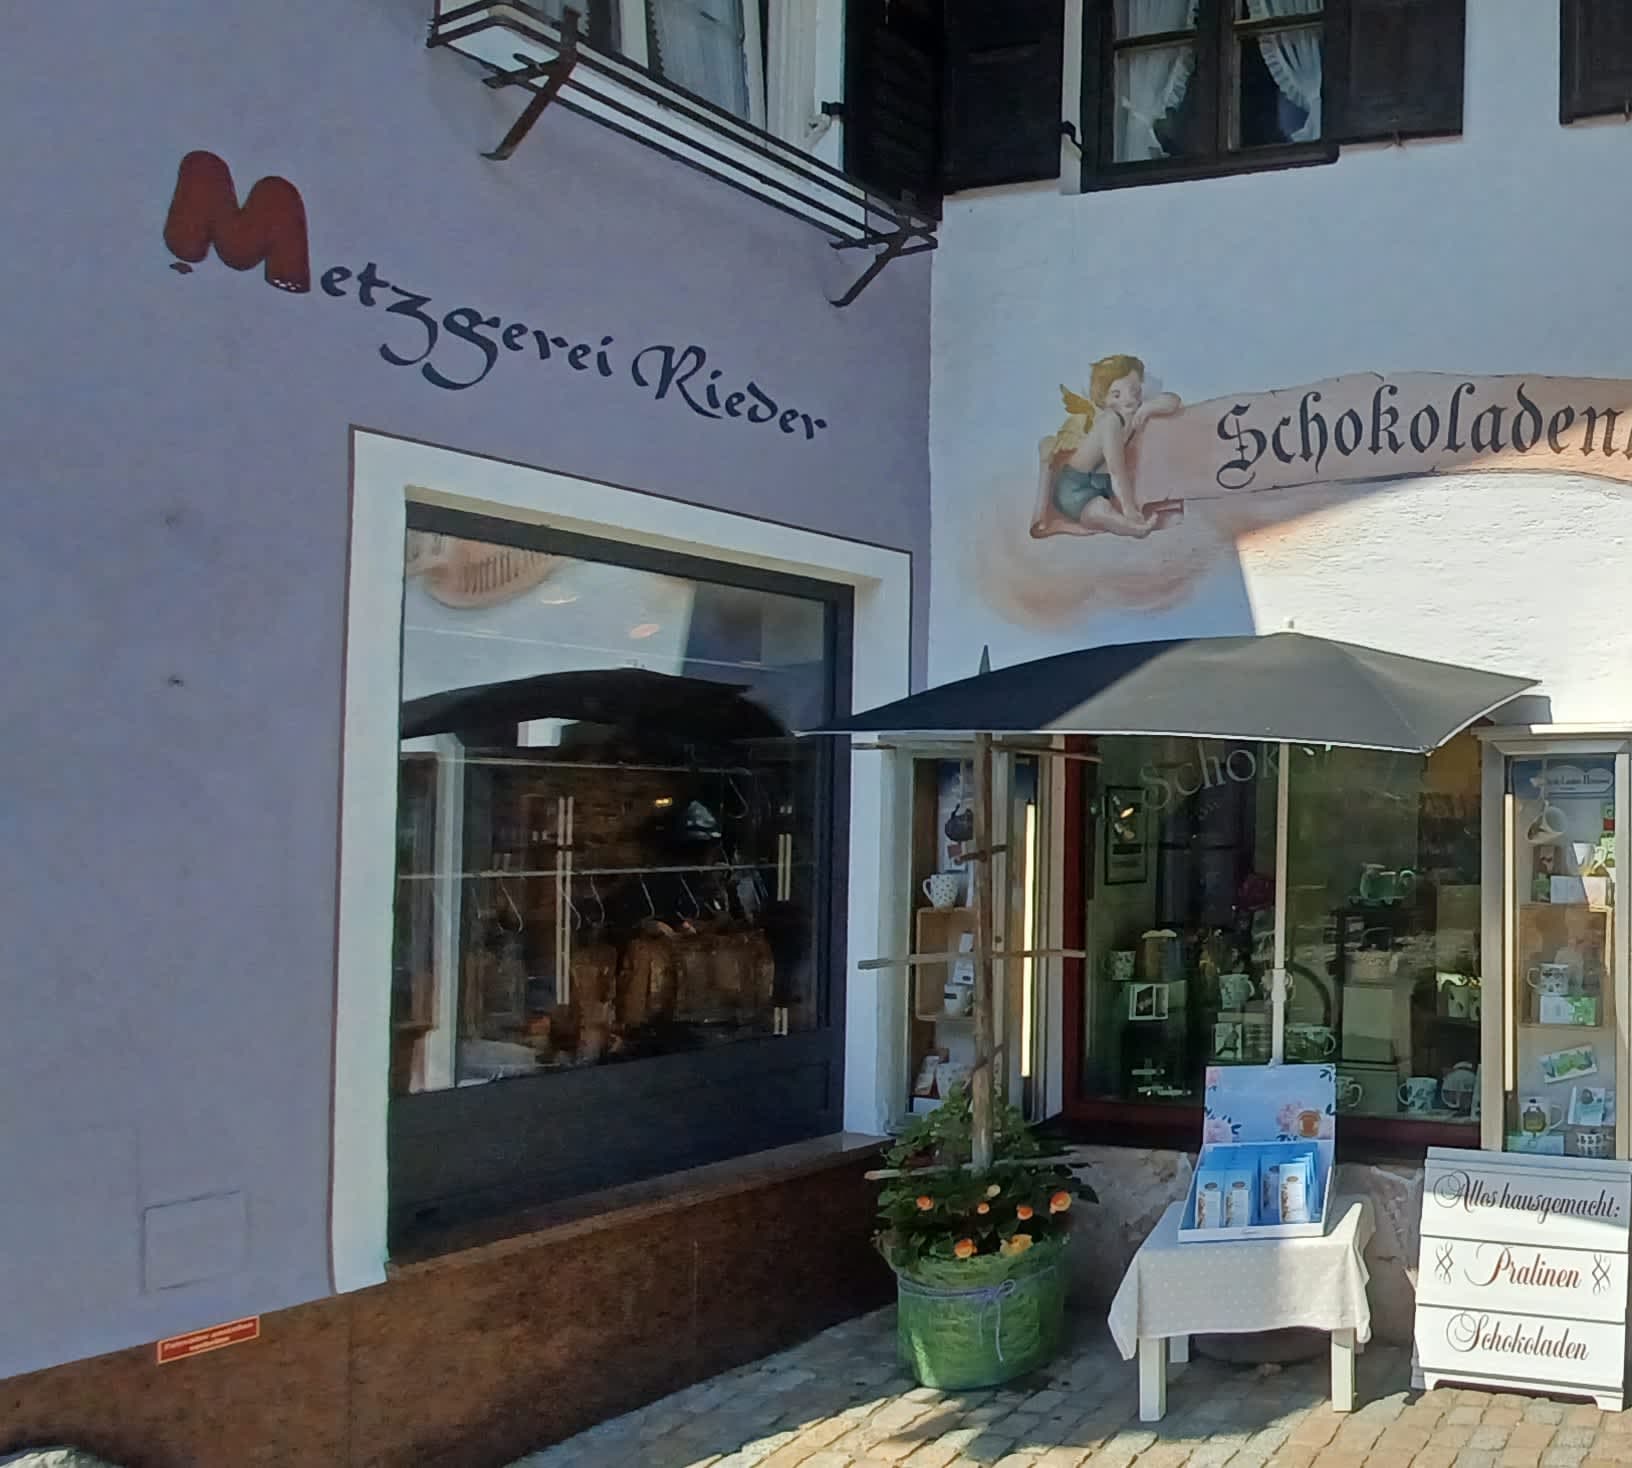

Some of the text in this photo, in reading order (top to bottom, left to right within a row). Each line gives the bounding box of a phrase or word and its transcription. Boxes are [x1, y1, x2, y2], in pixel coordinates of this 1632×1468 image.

[164, 149, 829, 441] Metzgerei Rieder
[1433, 1169, 1620, 1224] Alles hausgemacht:
[1464, 1242, 1582, 1289] Pralinen
[1446, 1311, 1589, 1361] Schokoladen
